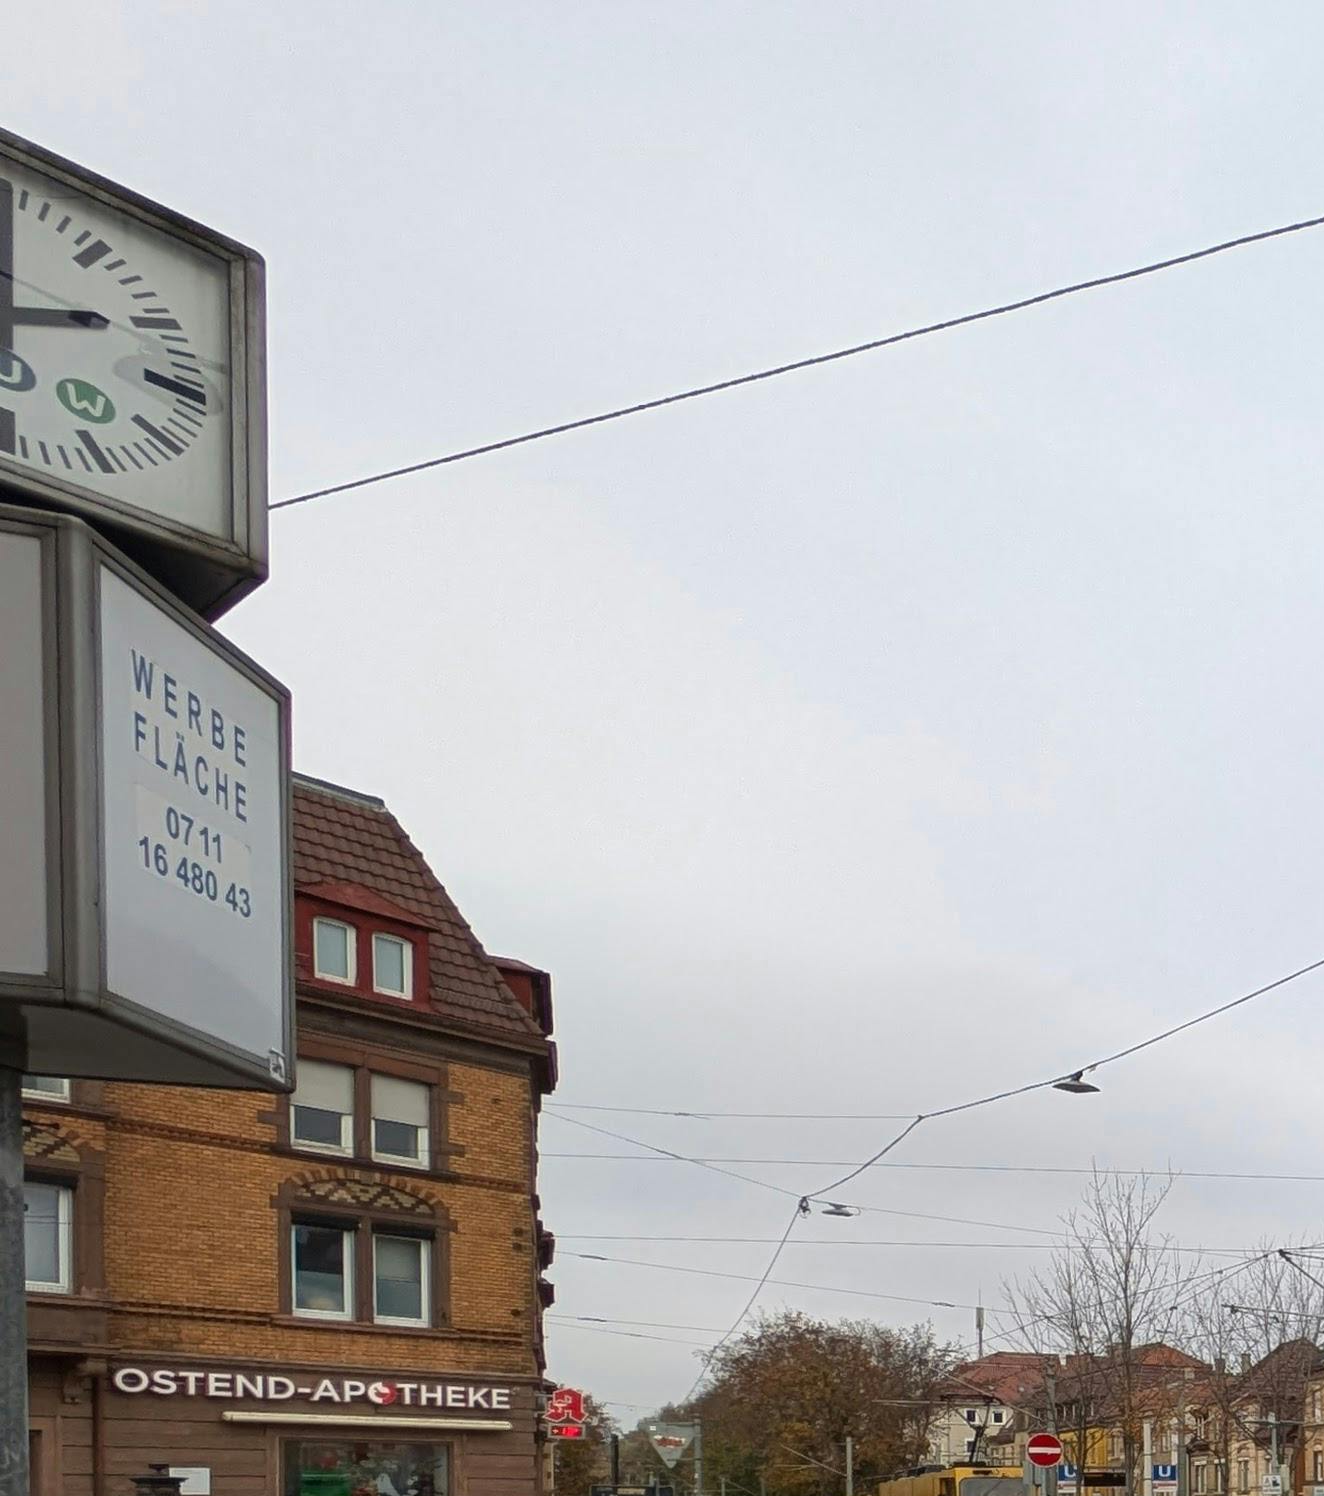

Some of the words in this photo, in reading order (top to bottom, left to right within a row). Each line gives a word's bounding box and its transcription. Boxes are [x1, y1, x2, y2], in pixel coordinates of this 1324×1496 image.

[66, 382, 106, 418] W
[131, 649, 246, 767] WERBE
[134, 711, 248, 823] FLÄCHE
[166, 806, 222, 863] 0711
[139, 836, 169, 877] 16
[176, 857, 218, 902] 480
[225, 882, 251, 918] 43
[114, 1367, 511, 1409] OSTEND-APOTHEKE
[1158, 1465, 1171, 1478] U
